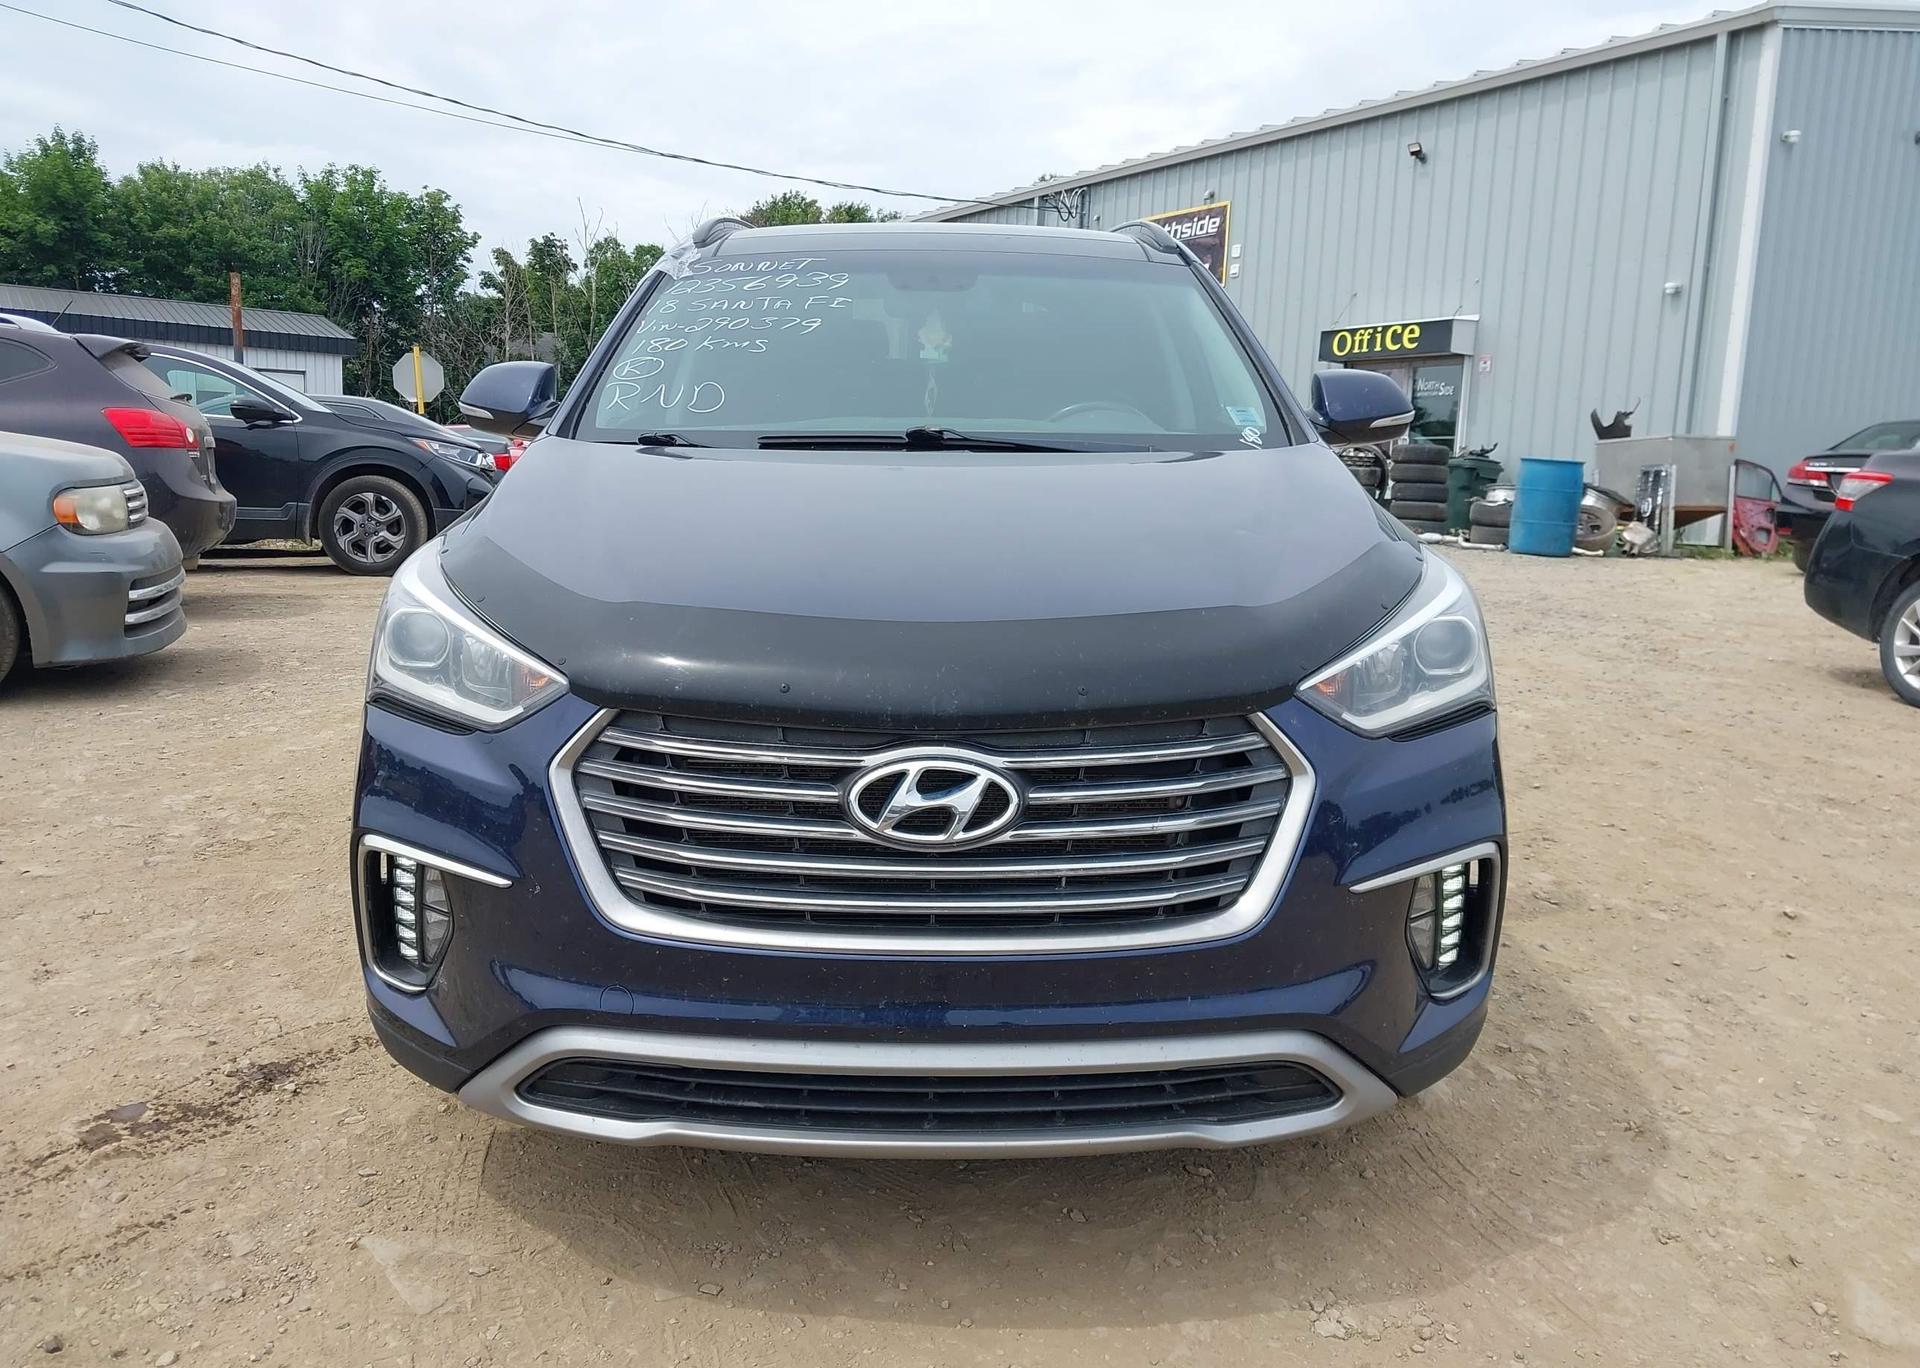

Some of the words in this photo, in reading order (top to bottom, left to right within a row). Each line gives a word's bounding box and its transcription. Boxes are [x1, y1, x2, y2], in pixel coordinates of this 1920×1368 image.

[687, 296, 793, 312] SANTA
[631, 338, 689, 355] 180
[1332, 324, 1421, 357] Office
